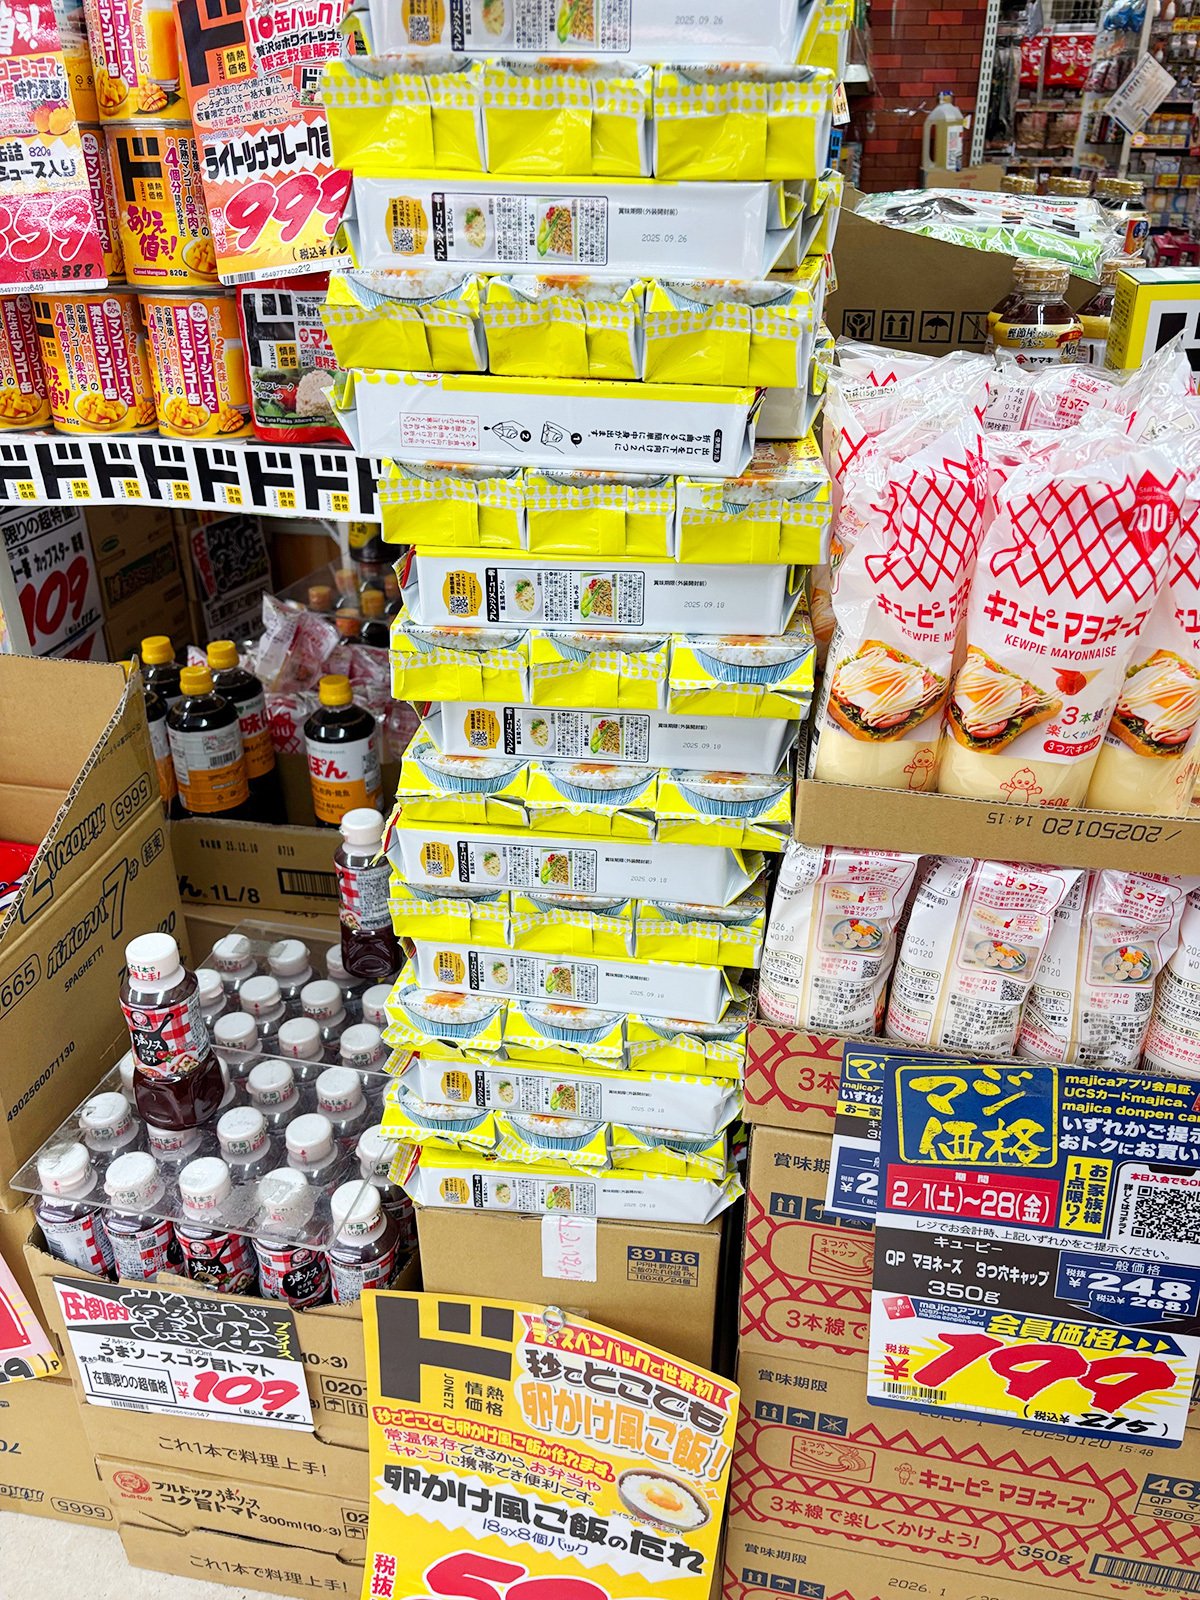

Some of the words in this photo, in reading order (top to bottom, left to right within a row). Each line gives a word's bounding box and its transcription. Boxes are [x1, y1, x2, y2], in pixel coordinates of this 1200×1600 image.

[249, 1, 343, 43] 10缶パック!
[216, 53, 225, 80] JONETZ
[261, 42, 340, 71] 限定数量販売
[116, 137, 163, 202] ド
[641, 233, 688, 244] 2025.09.26
[89, 305, 118, 400] 満たされマンゴー缶
[108, 318, 133, 404] マンゴージュースで
[175, 308, 201, 404] 満たされマンゴー缶
[193, 323, 215, 410] マンゴージュースで
[1029, 356, 1054, 364] ヤマキ
[35, 443, 88, 499] ド
[90, 442, 142, 498] ド
[138, 443, 190, 499] ド
[192, 447, 244, 502] ド
[245, 451, 295, 506] ド
[301, 456, 349, 510] ド
[19, 555, 89, 647] 109
[876, 592, 945, 628] キューピー
[983, 589, 1058, 637] キューピー
[1063, 607, 1149, 645] マヨネーズ
[901, 626, 940, 643] KEWPIE
[1004, 633, 1048, 656] KEWPIE
[1050, 645, 1117, 658] MAYONNAISE
[114, 775, 149, 823] 5665
[986, 810, 1032, 828] 14:15
[210, 884, 261, 904] 1L/8
[906, 935, 935, 948] 2026.1
[64, 946, 105, 994] SPAGHETTI
[6, 1040, 76, 1122] 4902560071130
[908, 1067, 1034, 1116] マジ
[1063, 1087, 1188, 1109] UCSカードmajica、
[1065, 1074, 1196, 1097] majicaアプリ会員証、
[1062, 1101, 1113, 1115] majica
[1115, 1105, 1175, 1121] donpen
[918, 1116, 1052, 1165] 価格
[1065, 1162, 1087, 1227] 1点限り!
[1083, 1164, 1108, 1225] お一家族様
[631, 1248, 696, 1265] 39186
[820, 1238, 849, 1250] 3つ穴
[820, 1247, 858, 1258] キャップ
[915, 1219, 1171, 1261] レジでお会計時、上記いずれかをご提示ください。
[933, 1236, 1004, 1253] キューピー
[885, 1250, 906, 1267] QP
[912, 1252, 963, 1275] マヨネーズ
[976, 1261, 1050, 1288] 3つ穴キャップ
[1066, 1267, 1087, 1279] 税抜
[1087, 1271, 1193, 1301] 248
[1099, 1260, 1161, 1276] 一般価格
[59, 1290, 130, 1321] 圧倒的
[919, 1302, 987, 1318] majicaアプリ
[927, 1279, 1001, 1305] 350g
[272, 1321, 295, 1361] プライス
[785, 1309, 868, 1340] 3本線で
[985, 1314, 1118, 1350] 会員価格
[99, 1342, 275, 1377] うまソースコク旨トマト
[185, 1347, 213, 1357] 300ml
[376, 1295, 515, 1404] ド
[885, 1343, 910, 1356] 税抜
[92, 1370, 169, 1395] 在庫限りの超価格
[758, 1368, 829, 1393] 賞味期限
[883, 1355, 910, 1381] ¥
[913, 1333, 1178, 1414] 199
[192, 1370, 300, 1411] 109
[443, 1373, 454, 1410] JONETZ
[465, 1380, 505, 1401] 情熱
[465, 1396, 504, 1418] 価格
[525, 1349, 725, 1434] 秒でどこでも
[374, 1407, 616, 1483] 秒でどこでも卵かけ風ご飯が作れます。
[522, 1382, 730, 1480] 卵かけ風ご飯!
[800, 1439, 826, 1450] 3つ穴
[158, 1436, 327, 1477] これ1本で料理上手!
[384, 1427, 602, 1492] 常温保存できるから、お弁当や
[800, 1446, 834, 1458] キャップ
[1118, 1444, 1155, 1457] 15:48
[152, 1481, 213, 1498] ブルドック
[389, 1441, 597, 1506] キャンプに携帯でき便利です。
[57, 1501, 106, 1518] 5665
[160, 1493, 260, 1519] コク旨トマト
[918, 1469, 994, 1499] キューピー
[999, 1482, 1095, 1516] マヨネーズ
[1149, 1496, 1173, 1506] QP
[383, 1464, 705, 1574] 卵かけ風ご飯のたれ
[769, 1496, 980, 1549] 3本線で楽しくかけよう!
[744, 1542, 808, 1565] 賞味期限
[1017, 1545, 1074, 1565] 350g
[190, 1554, 348, 1593] これ1本で料理上手!
[372, 1553, 396, 1598] 税抜
